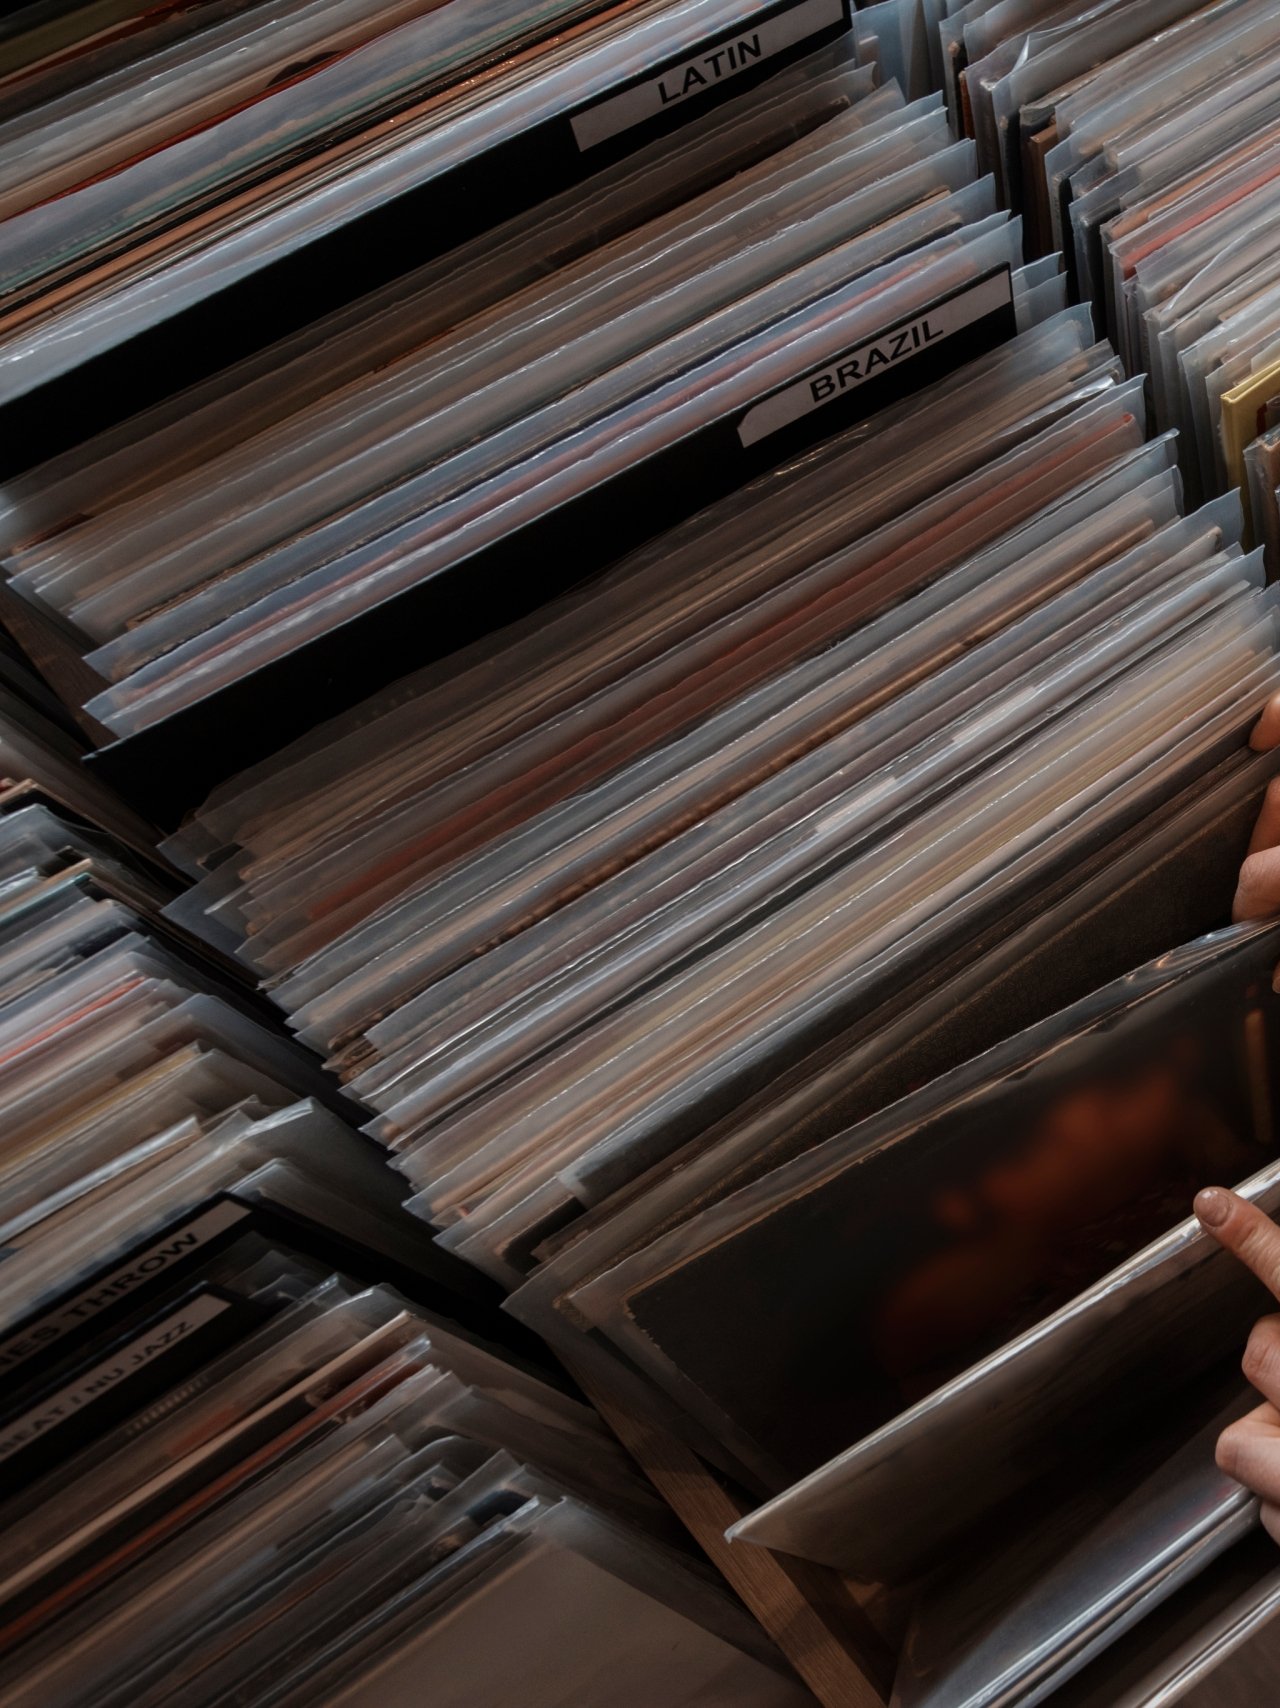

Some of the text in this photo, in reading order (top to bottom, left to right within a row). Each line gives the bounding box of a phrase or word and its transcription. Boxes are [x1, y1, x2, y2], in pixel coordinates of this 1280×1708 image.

[658, 34, 761, 104] LATIN
[809, 321, 943, 402] BRAZIL
[63, 1233, 197, 1316] THROW
[84, 1368, 124, 1394] NU
[132, 1321, 193, 1366] JAZZ
